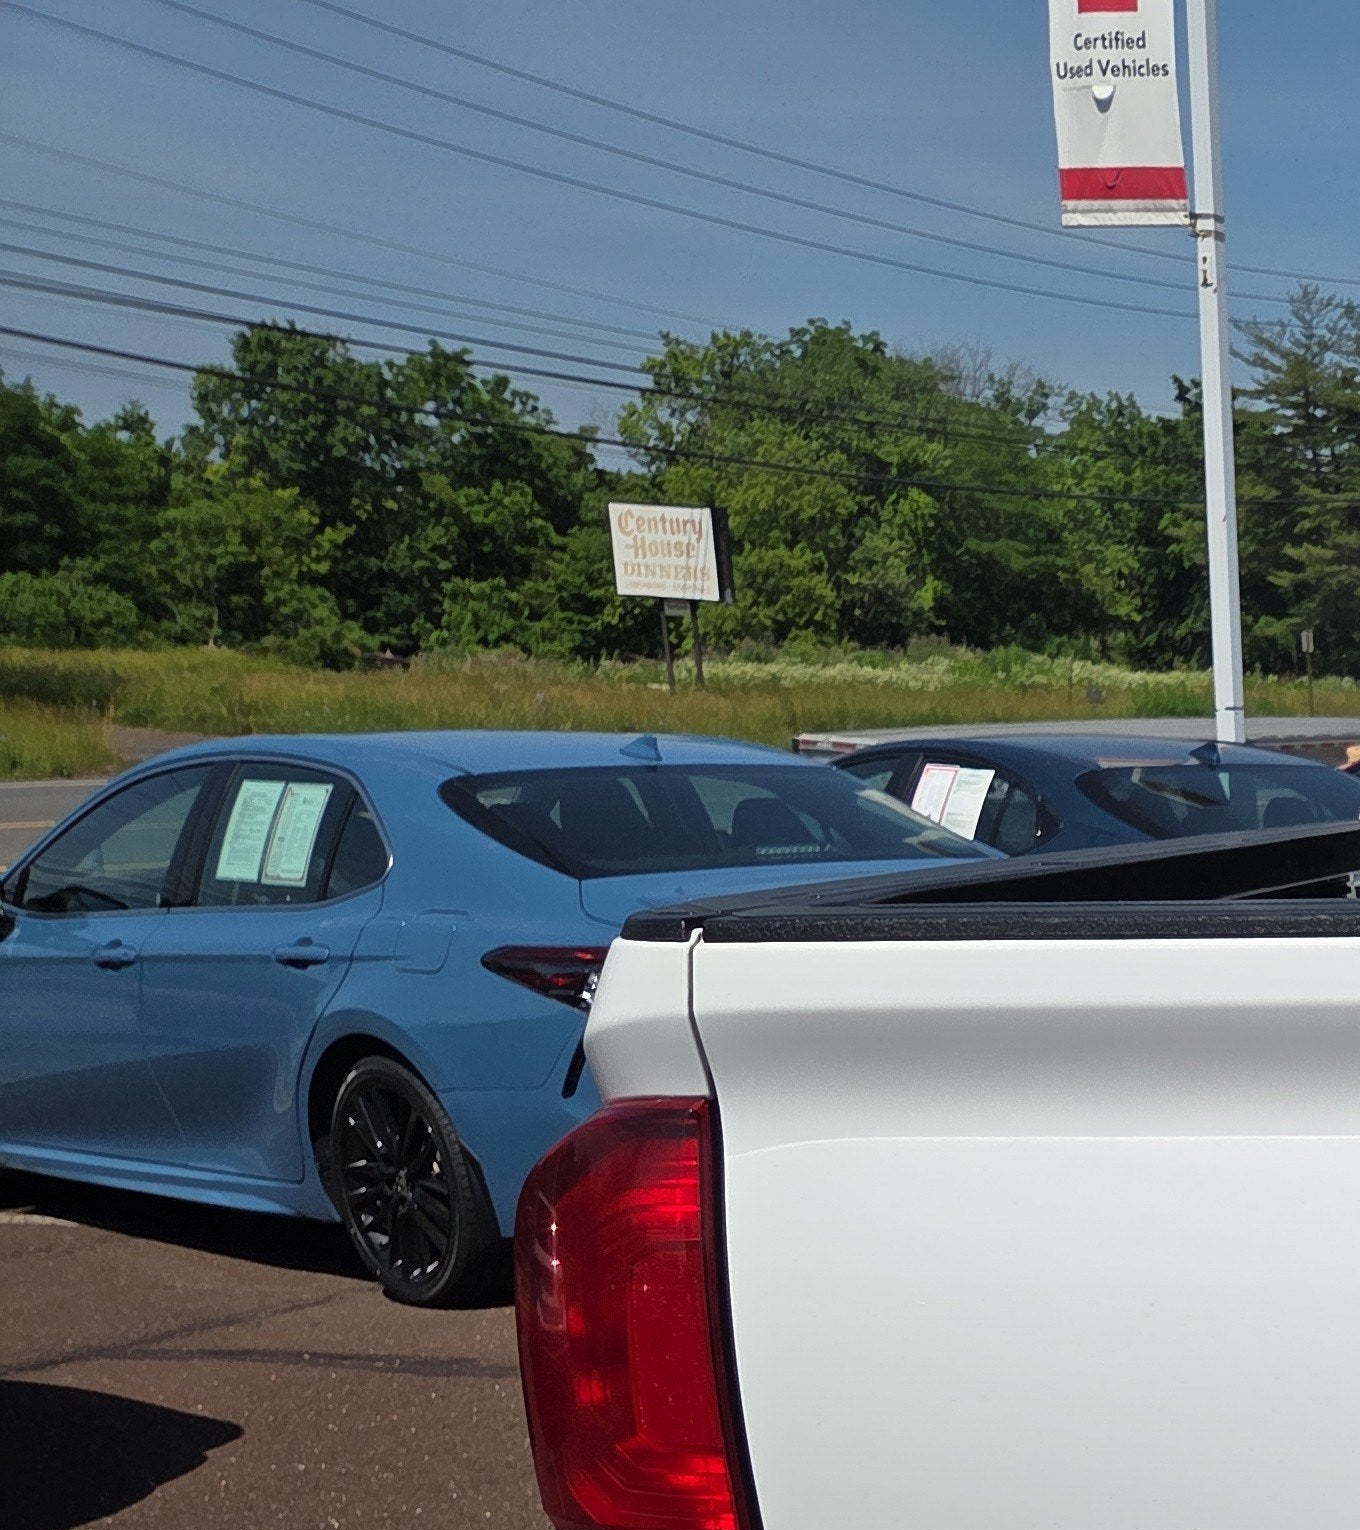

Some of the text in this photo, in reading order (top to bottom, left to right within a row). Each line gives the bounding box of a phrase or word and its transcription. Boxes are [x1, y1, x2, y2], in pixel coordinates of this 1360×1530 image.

[1073, 30, 1147, 51] Certified
[1055, 58, 1170, 80] Used Vehicles
[617, 508, 704, 543] Century
[624, 534, 696, 560] House
